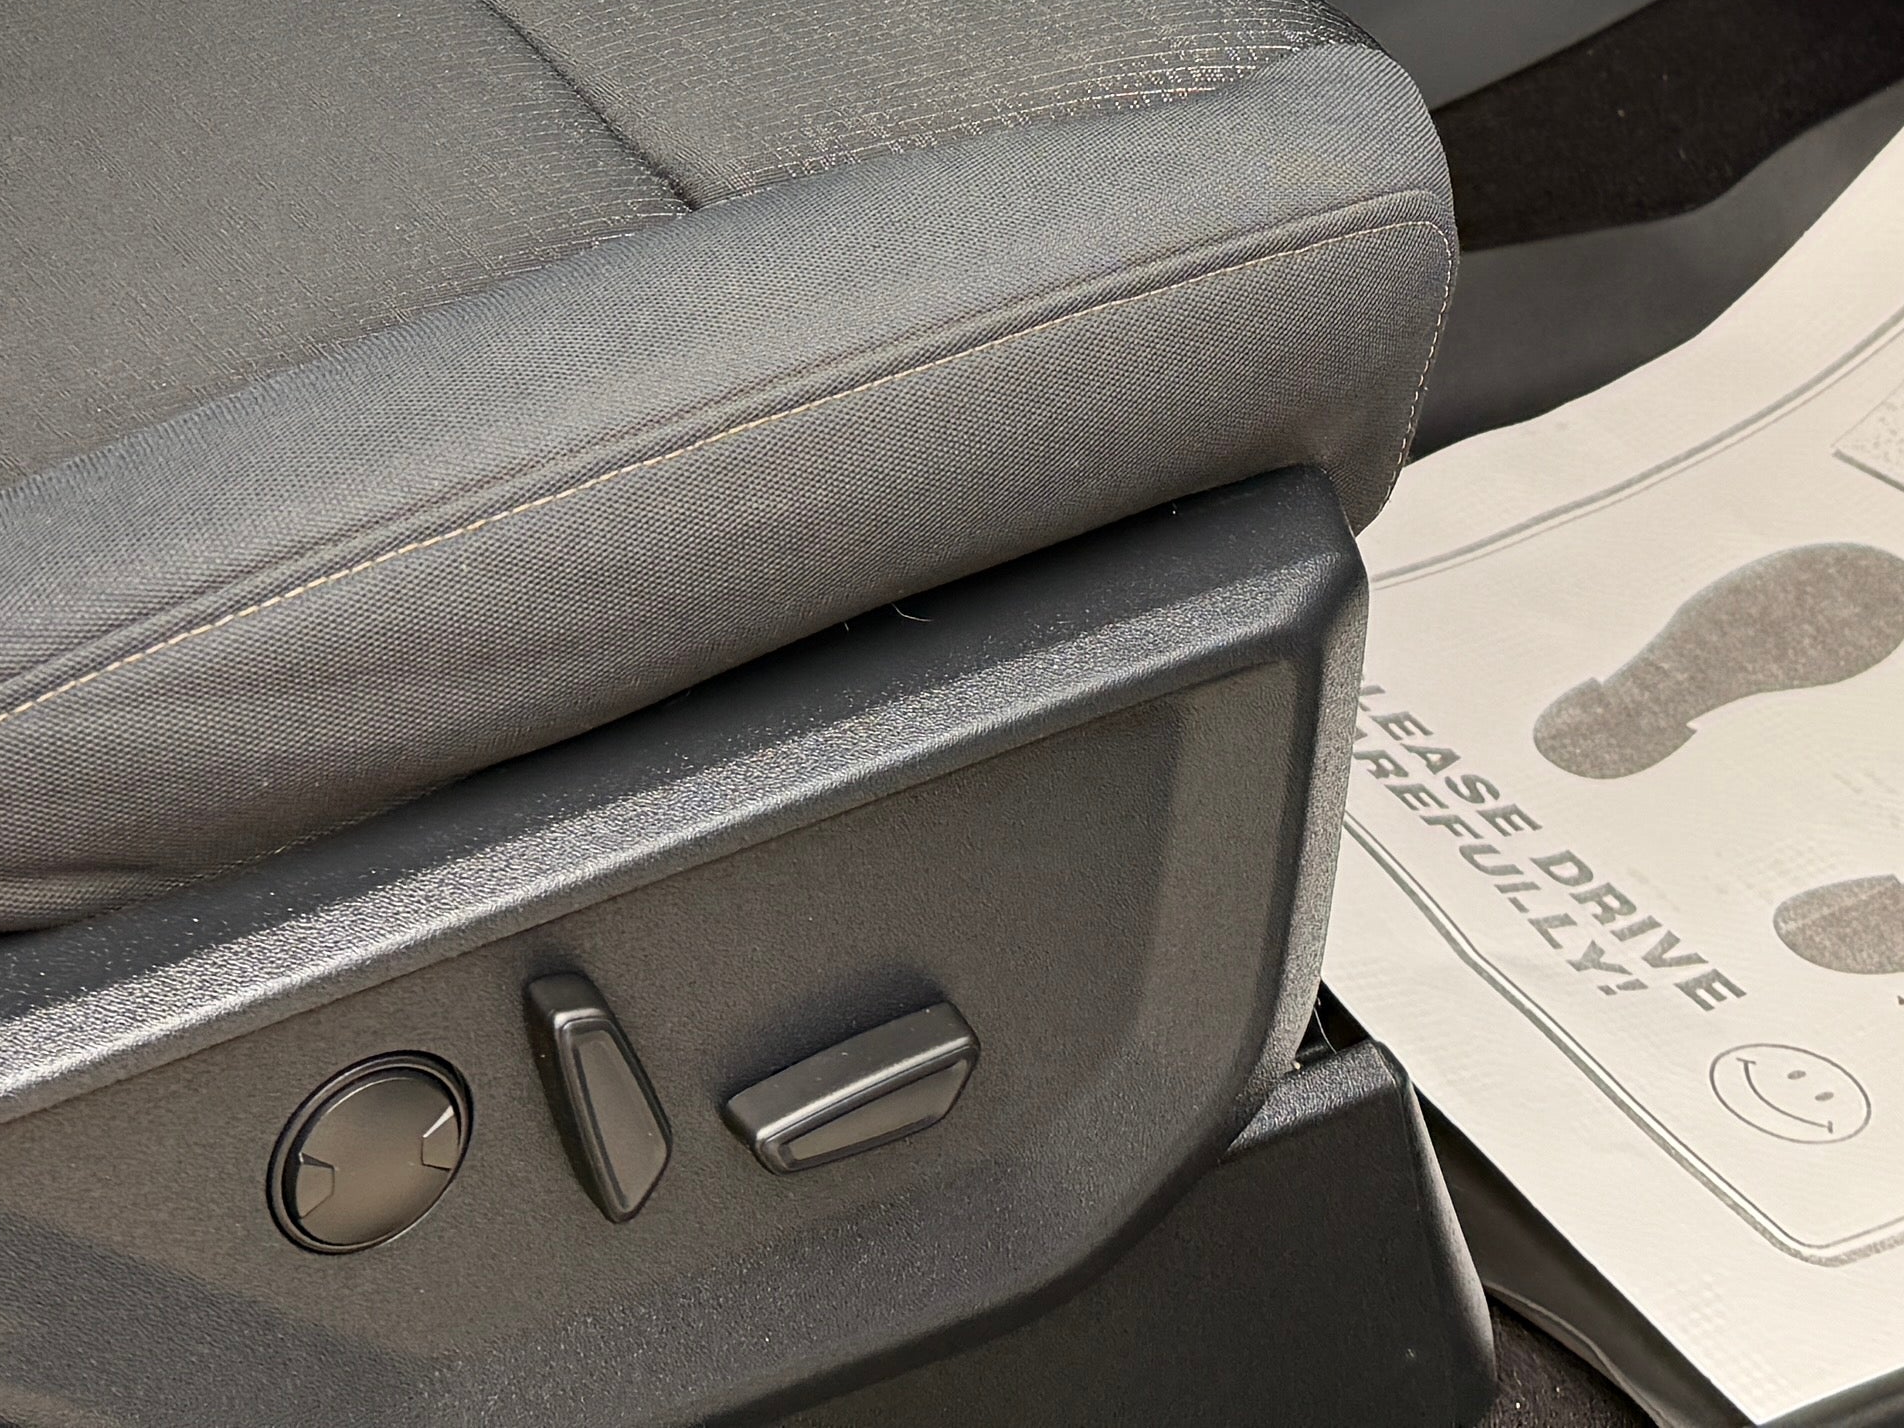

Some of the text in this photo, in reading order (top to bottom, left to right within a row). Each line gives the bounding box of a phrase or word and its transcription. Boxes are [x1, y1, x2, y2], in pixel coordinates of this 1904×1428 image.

[1351, 727, 1650, 997] REFULLY!
[1358, 684, 1748, 1012] LEASE DRIVE
